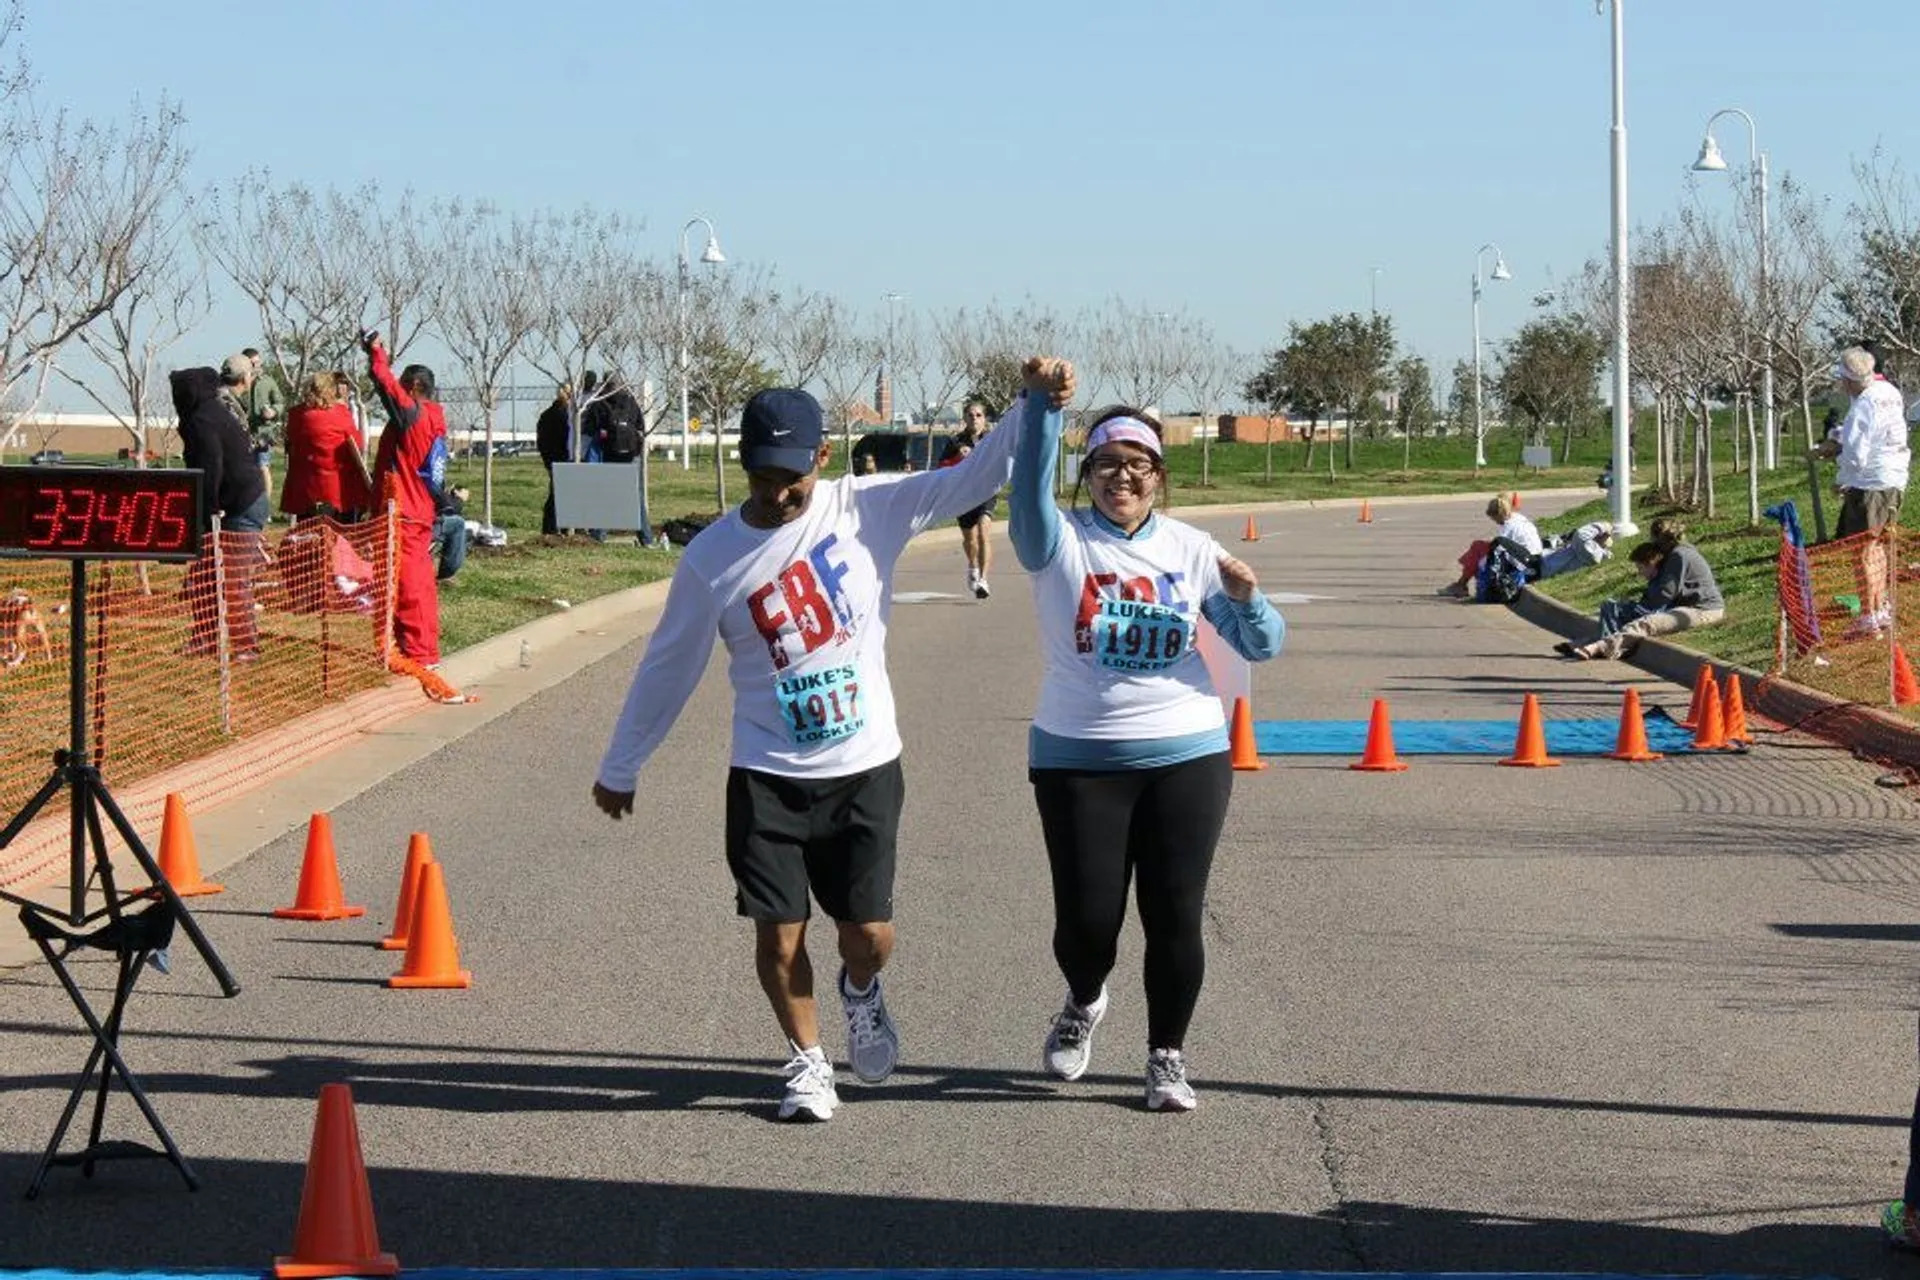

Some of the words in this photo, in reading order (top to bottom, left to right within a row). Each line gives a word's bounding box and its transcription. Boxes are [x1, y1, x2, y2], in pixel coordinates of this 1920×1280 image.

[1107, 602, 1183, 623] LUKE'S
[1104, 622, 1182, 659] 1918
[781, 664, 855, 696] LUKE'S
[787, 682, 858, 731] 1917
